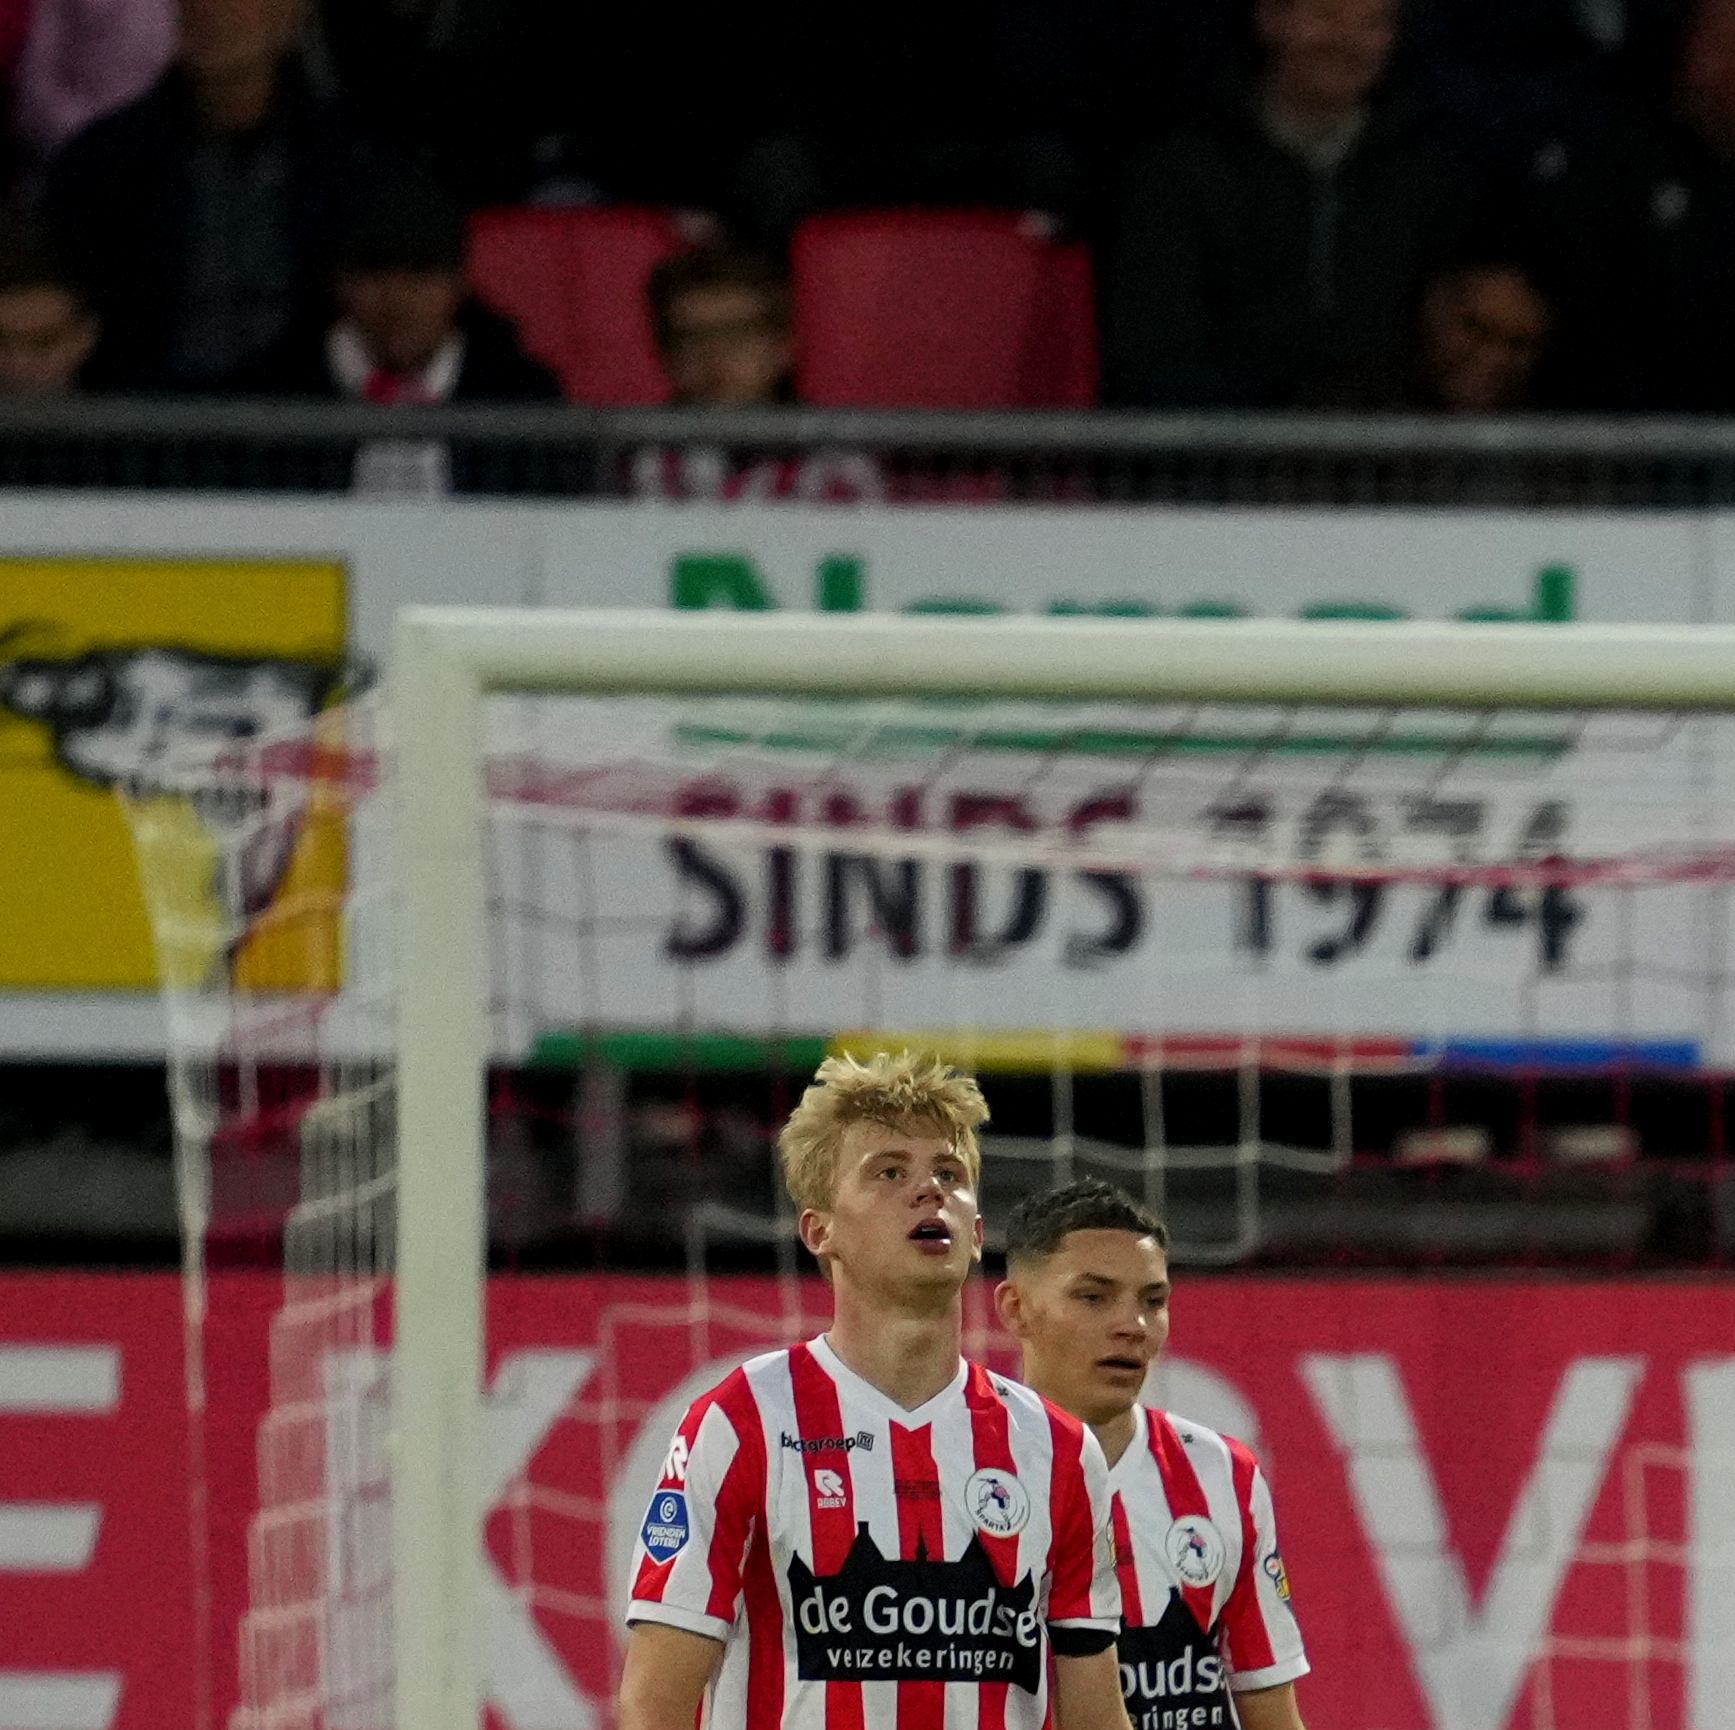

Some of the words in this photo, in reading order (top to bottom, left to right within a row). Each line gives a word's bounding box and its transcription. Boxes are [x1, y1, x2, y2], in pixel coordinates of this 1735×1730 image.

[665, 776, 1148, 966] SINDS
[1206, 788, 1585, 972] 1974
[800, 1585, 852, 1635] de
[863, 1585, 1038, 1648] Goudse
